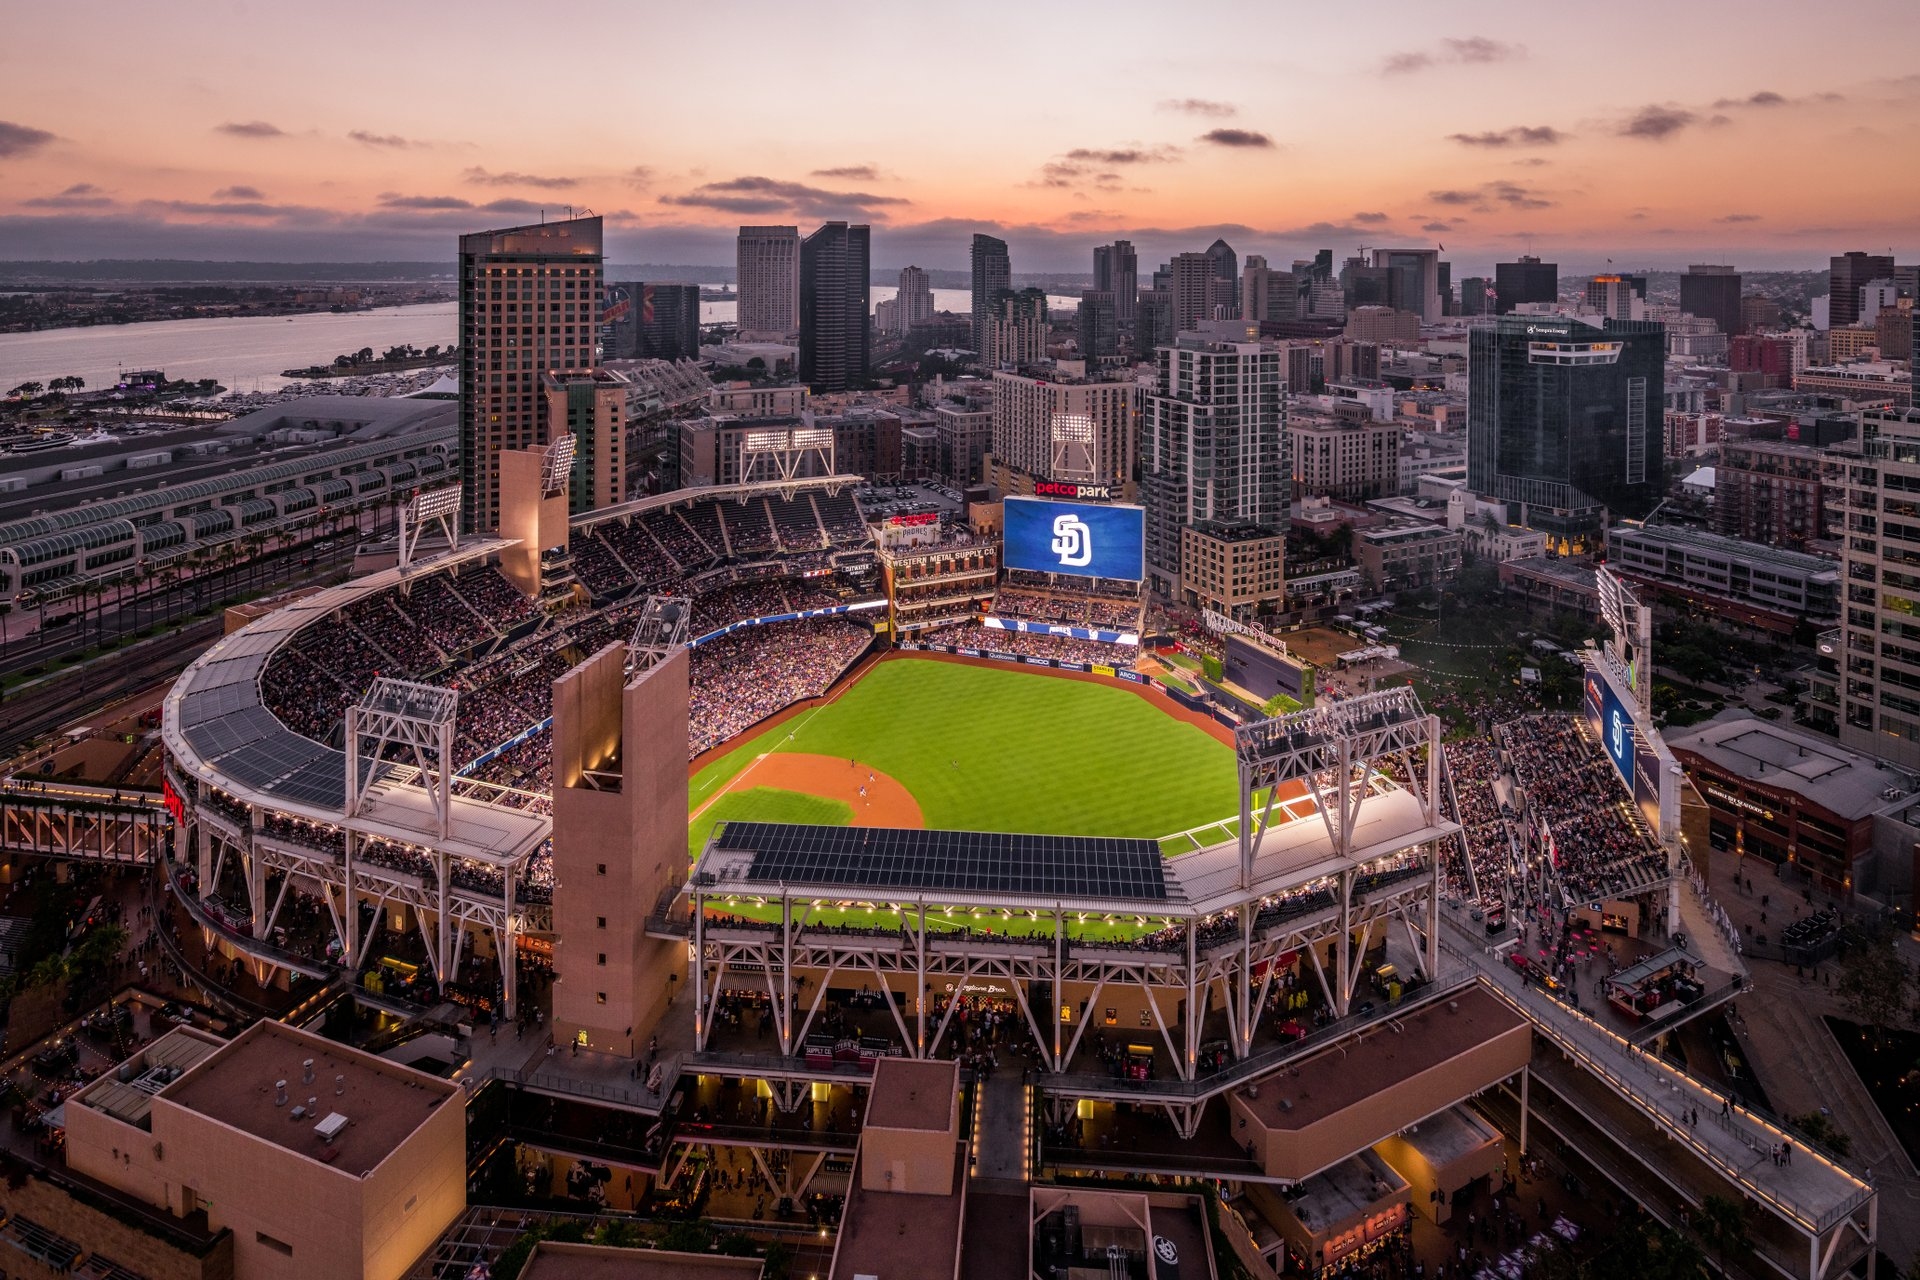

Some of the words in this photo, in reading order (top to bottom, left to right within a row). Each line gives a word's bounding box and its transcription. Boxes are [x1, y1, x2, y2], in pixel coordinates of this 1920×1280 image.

[903, 527, 928, 537] PADRES
[894, 556, 927, 567] WESTERN
[930, 553, 953, 563] METAL
[955, 549, 982, 559] SUPPLY
[989, 653, 1016, 662] Qualcomm
[1027, 657, 1049, 666] GEICO
[1093, 665, 1114, 674] STANLEY
[1119, 671, 1137, 680] ARCO
[1707, 787, 1727, 800] BUMBLE
[860, 1050, 877, 1058] SUPPLY
